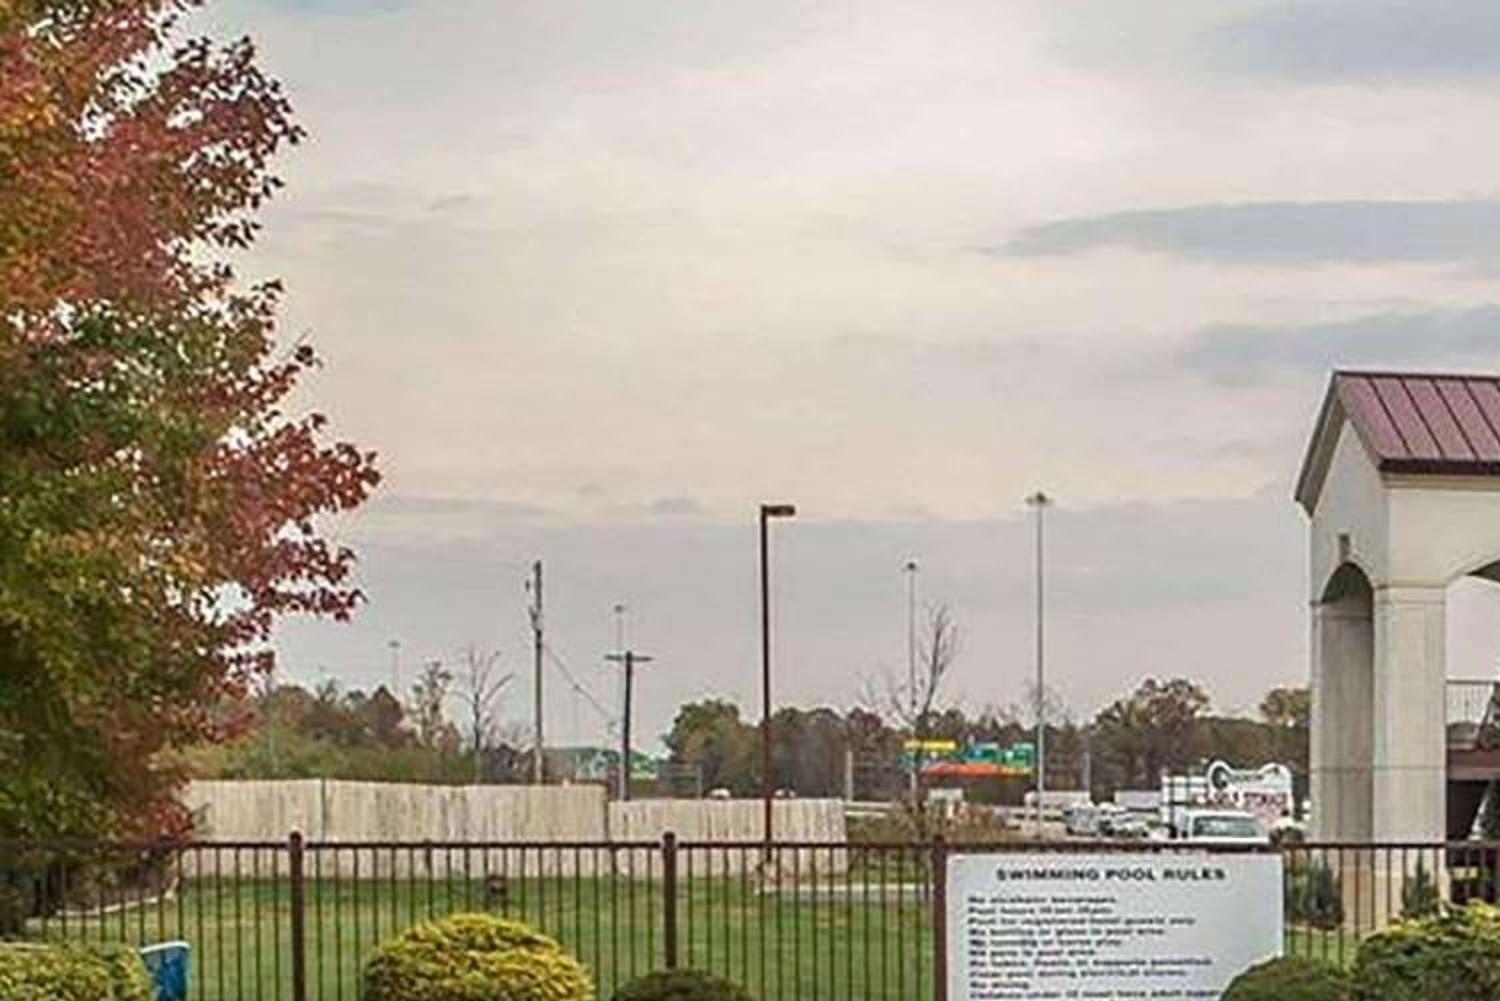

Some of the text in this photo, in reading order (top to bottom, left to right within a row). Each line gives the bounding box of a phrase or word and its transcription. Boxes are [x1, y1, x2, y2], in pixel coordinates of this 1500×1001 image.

[996, 868, 1226, 881] SWIMMING POOL RULES
